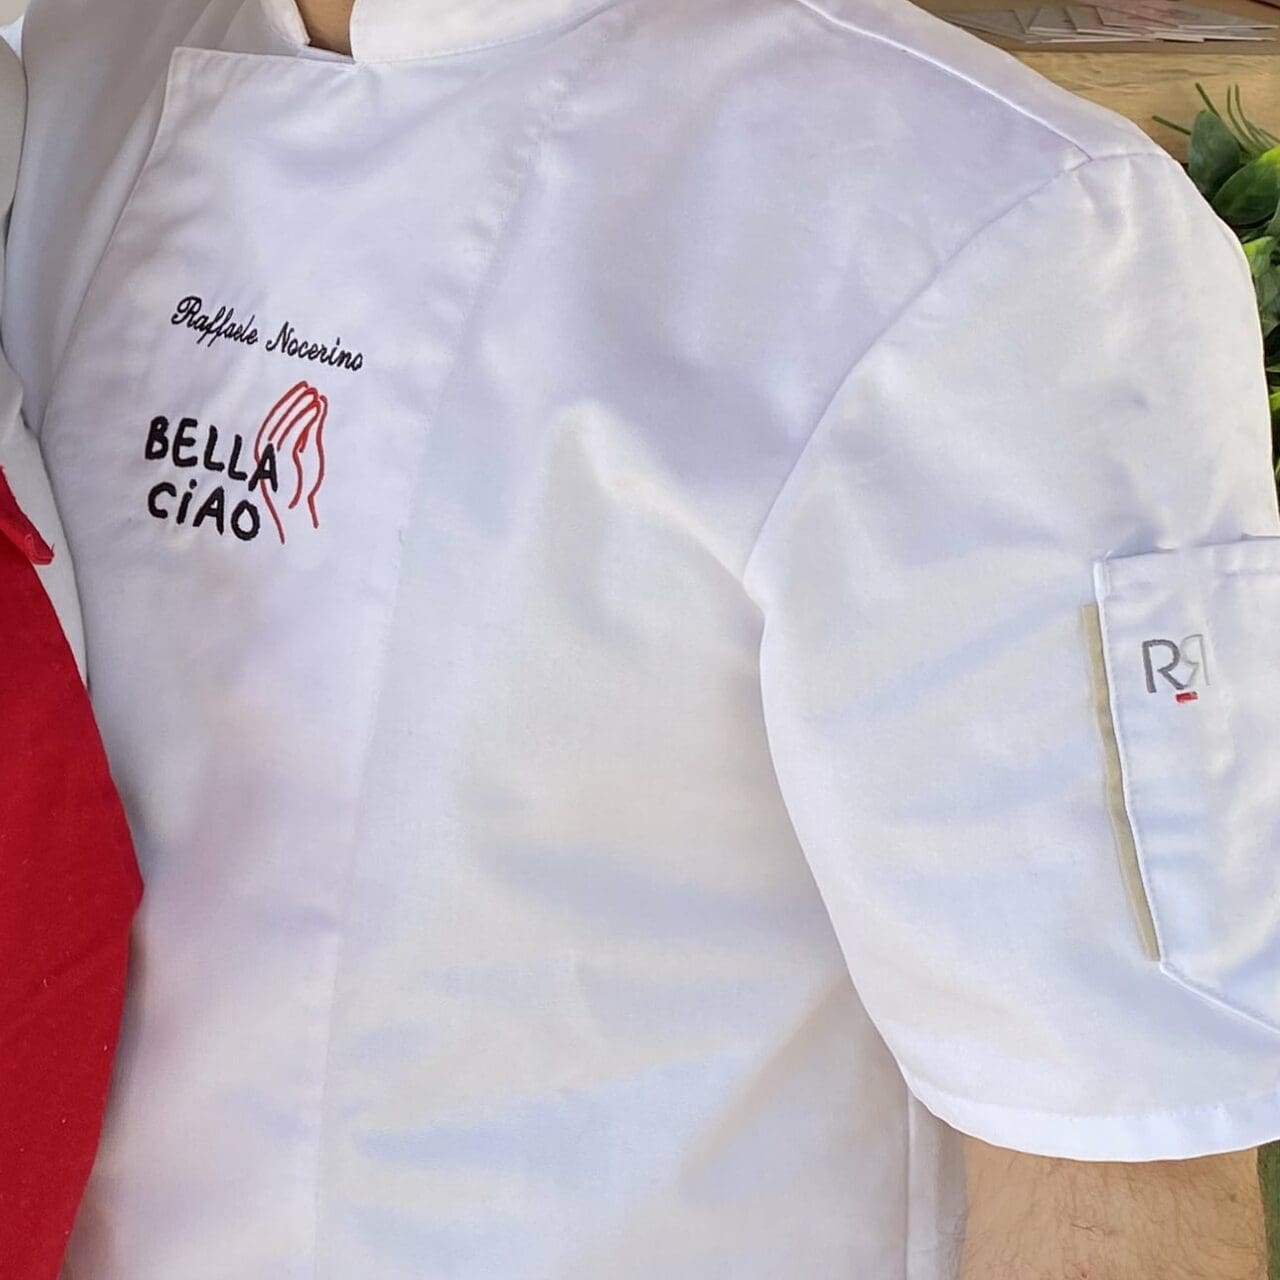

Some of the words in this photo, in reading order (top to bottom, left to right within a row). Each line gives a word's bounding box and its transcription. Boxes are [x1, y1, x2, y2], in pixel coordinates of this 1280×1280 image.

[171, 296, 258, 347] Raffaele
[266, 321, 364, 371] Nocerino
[145, 416, 278, 492] BELLA
